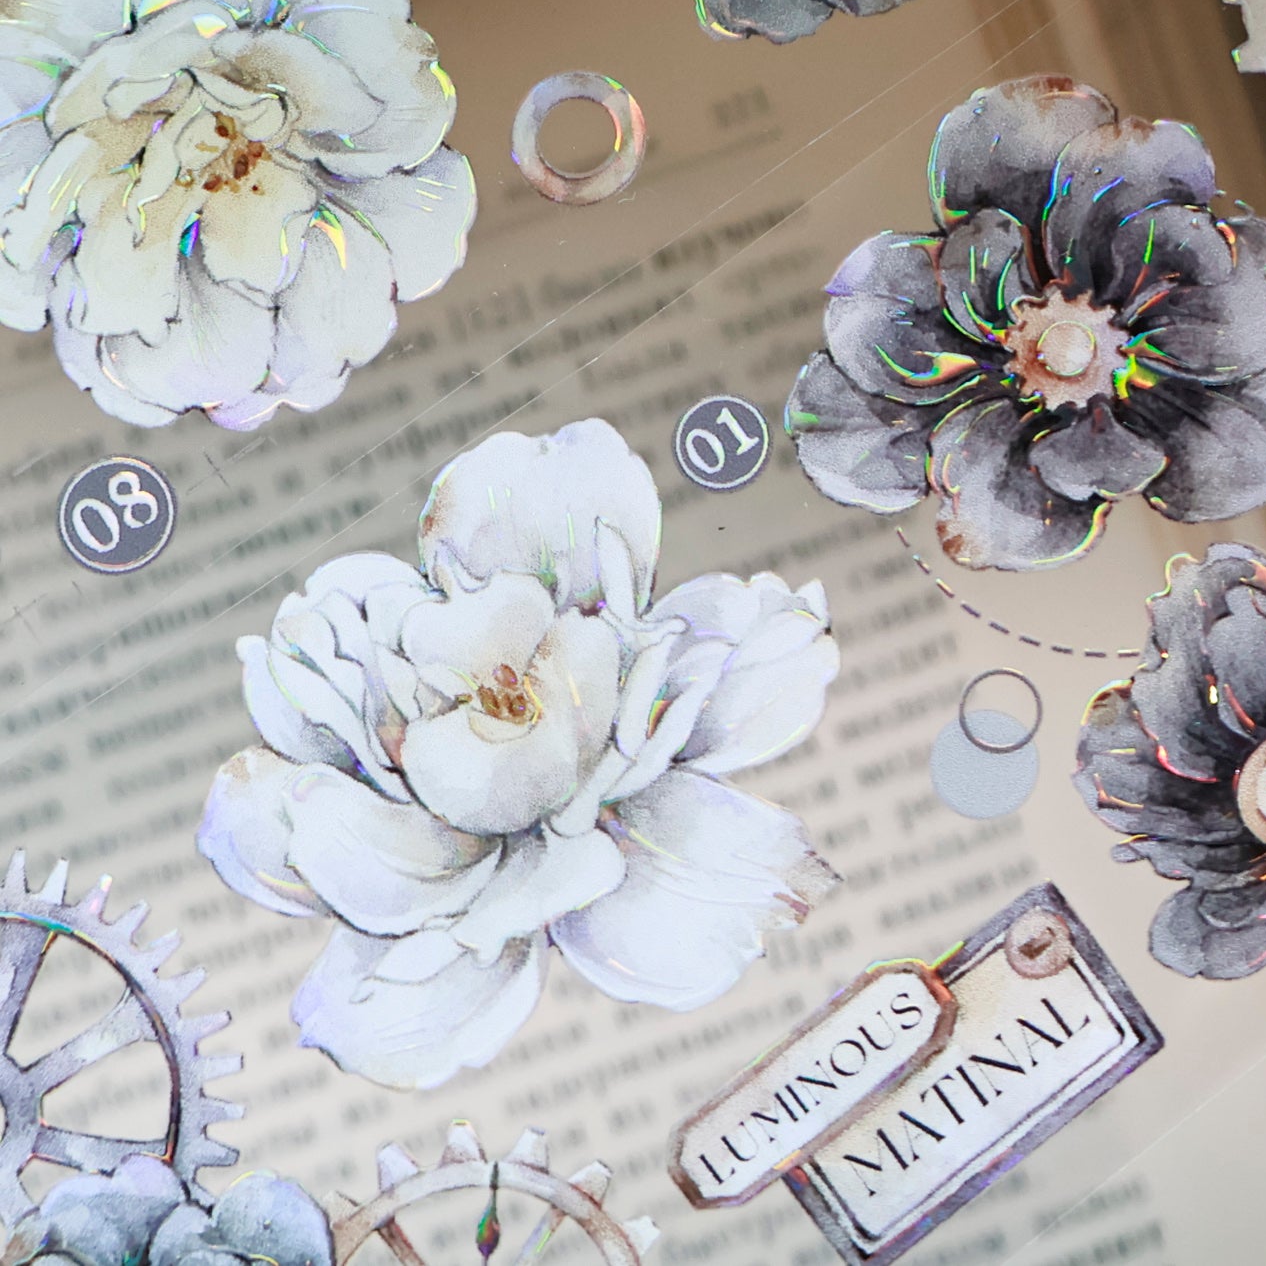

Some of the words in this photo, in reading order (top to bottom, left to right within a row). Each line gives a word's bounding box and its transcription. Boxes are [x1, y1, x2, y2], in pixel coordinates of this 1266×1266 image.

[685, 407, 760, 474] 01
[72, 471, 159, 553] 08
[698, 992, 923, 1185] LUMINOUS
[843, 998, 1090, 1197] MATINAL
